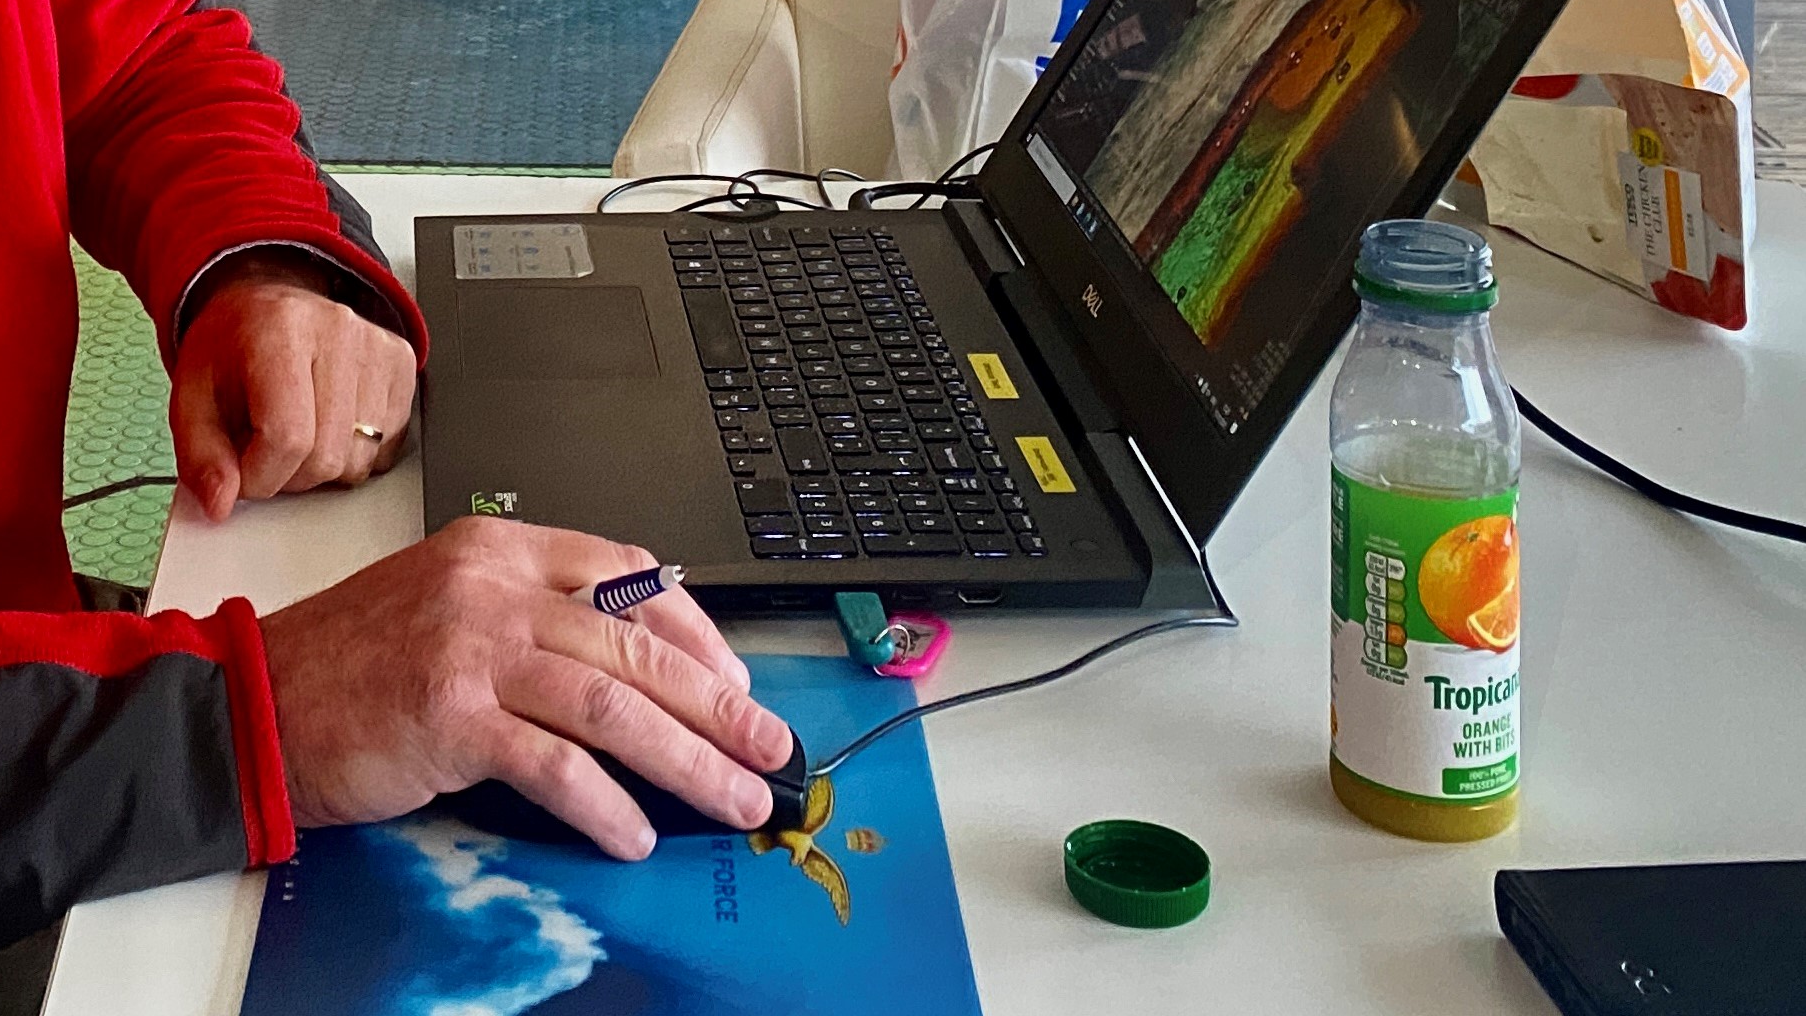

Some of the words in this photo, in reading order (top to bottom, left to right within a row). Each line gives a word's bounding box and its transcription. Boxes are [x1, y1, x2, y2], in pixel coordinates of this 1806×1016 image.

[1624, 183, 1638, 227] TESCO
[1637, 163, 1654, 227] CHICKEN
[1650, 195, 1664, 234] CLUB
[1643, 229, 1656, 257] THE
[1081, 284, 1103, 318] DELL
[1424, 672, 1520, 715] Tropican
[1452, 740, 1492, 759] WITH
[1495, 730, 1516, 753] BITS
[1462, 713, 1512, 740] ORANGE
[1458, 778, 1496, 792] PRESSED
[712, 858, 739, 924] FORCE
